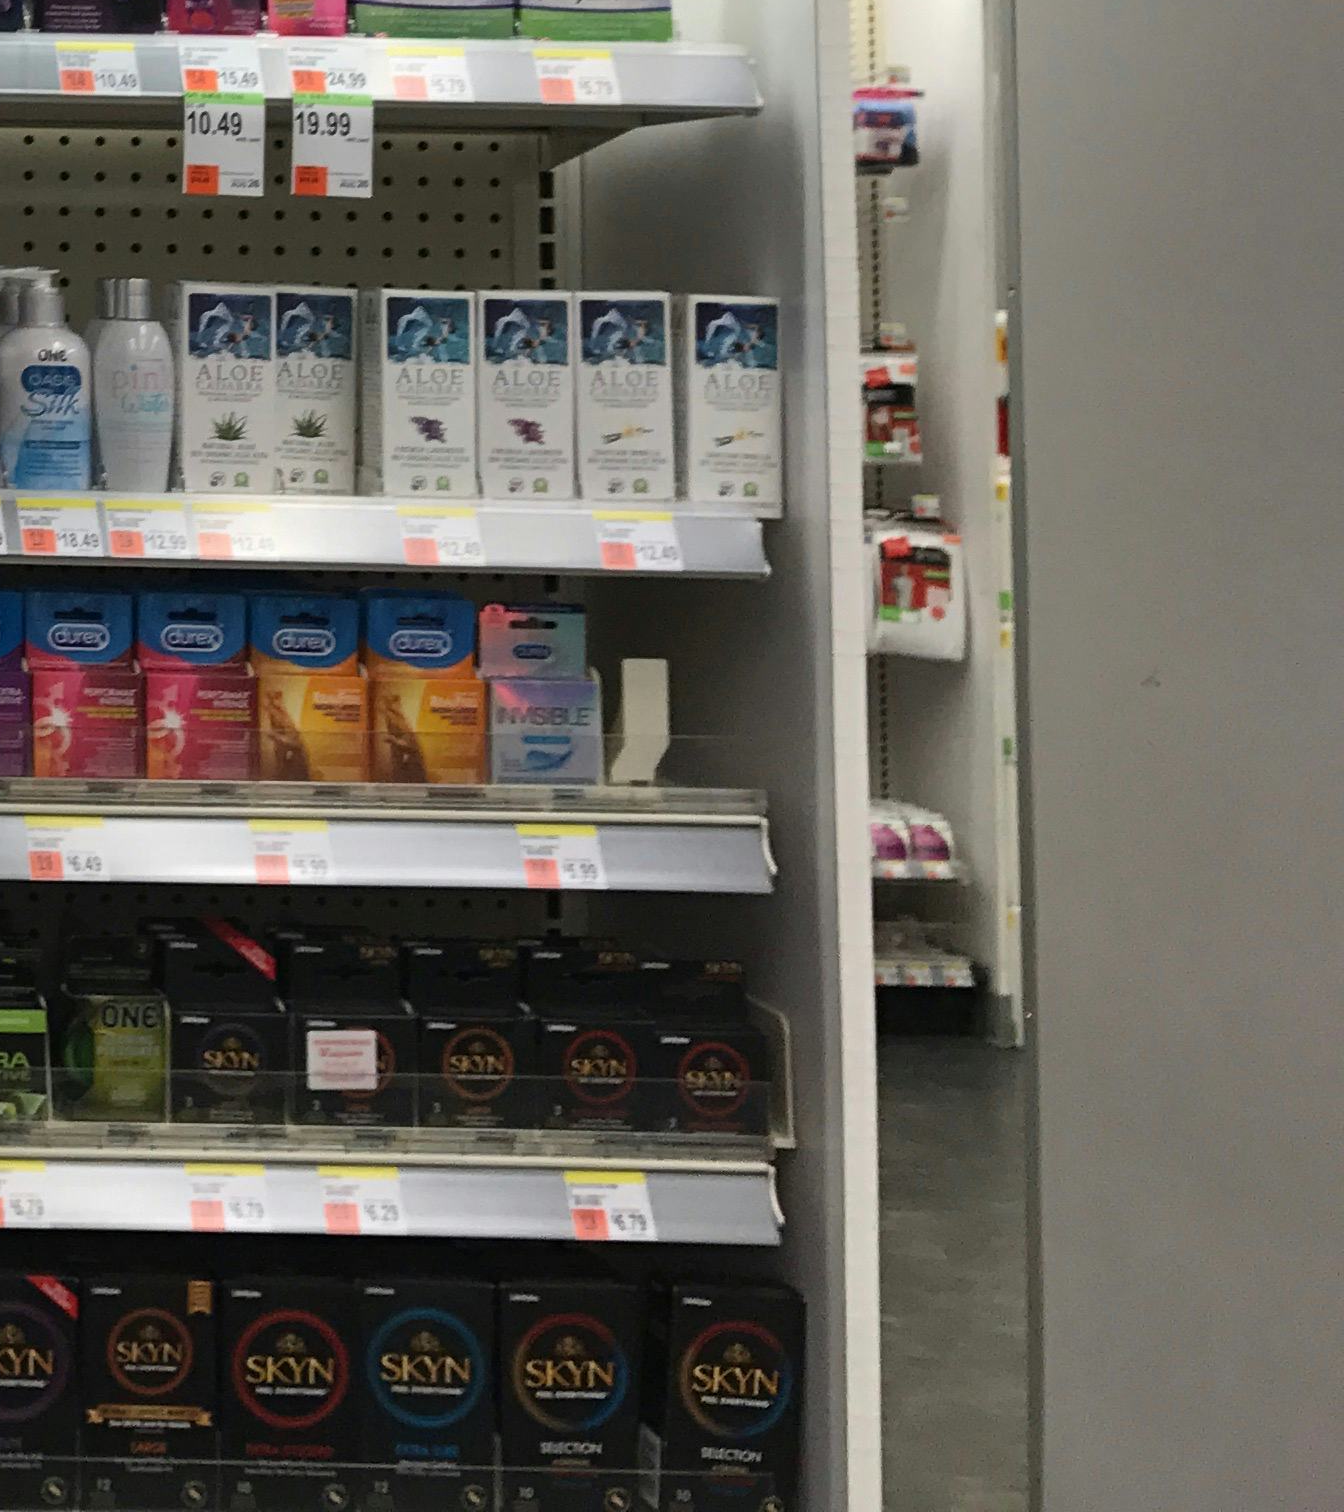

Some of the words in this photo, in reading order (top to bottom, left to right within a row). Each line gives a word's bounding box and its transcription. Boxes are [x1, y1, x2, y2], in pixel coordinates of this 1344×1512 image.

[186, 110, 242, 139] 10.49
[294, 110, 352, 138] 19.99
[196, 364, 264, 384] ALOE
[276, 360, 344, 381] ALOE
[395, 368, 464, 388] ALOE
[492, 369, 561, 388] ALOE
[590, 369, 658, 389] ALOE
[703, 372, 770, 392] ALOE
[54, 626, 104, 649] durex
[168, 628, 218, 650] durex
[280, 633, 330, 654] durex
[116, 1340, 183, 1363] SKYN
[245, 1354, 335, 1385] SKYN
[380, 1354, 471, 1383] SKYN
[691, 1364, 779, 1396] SKYN
